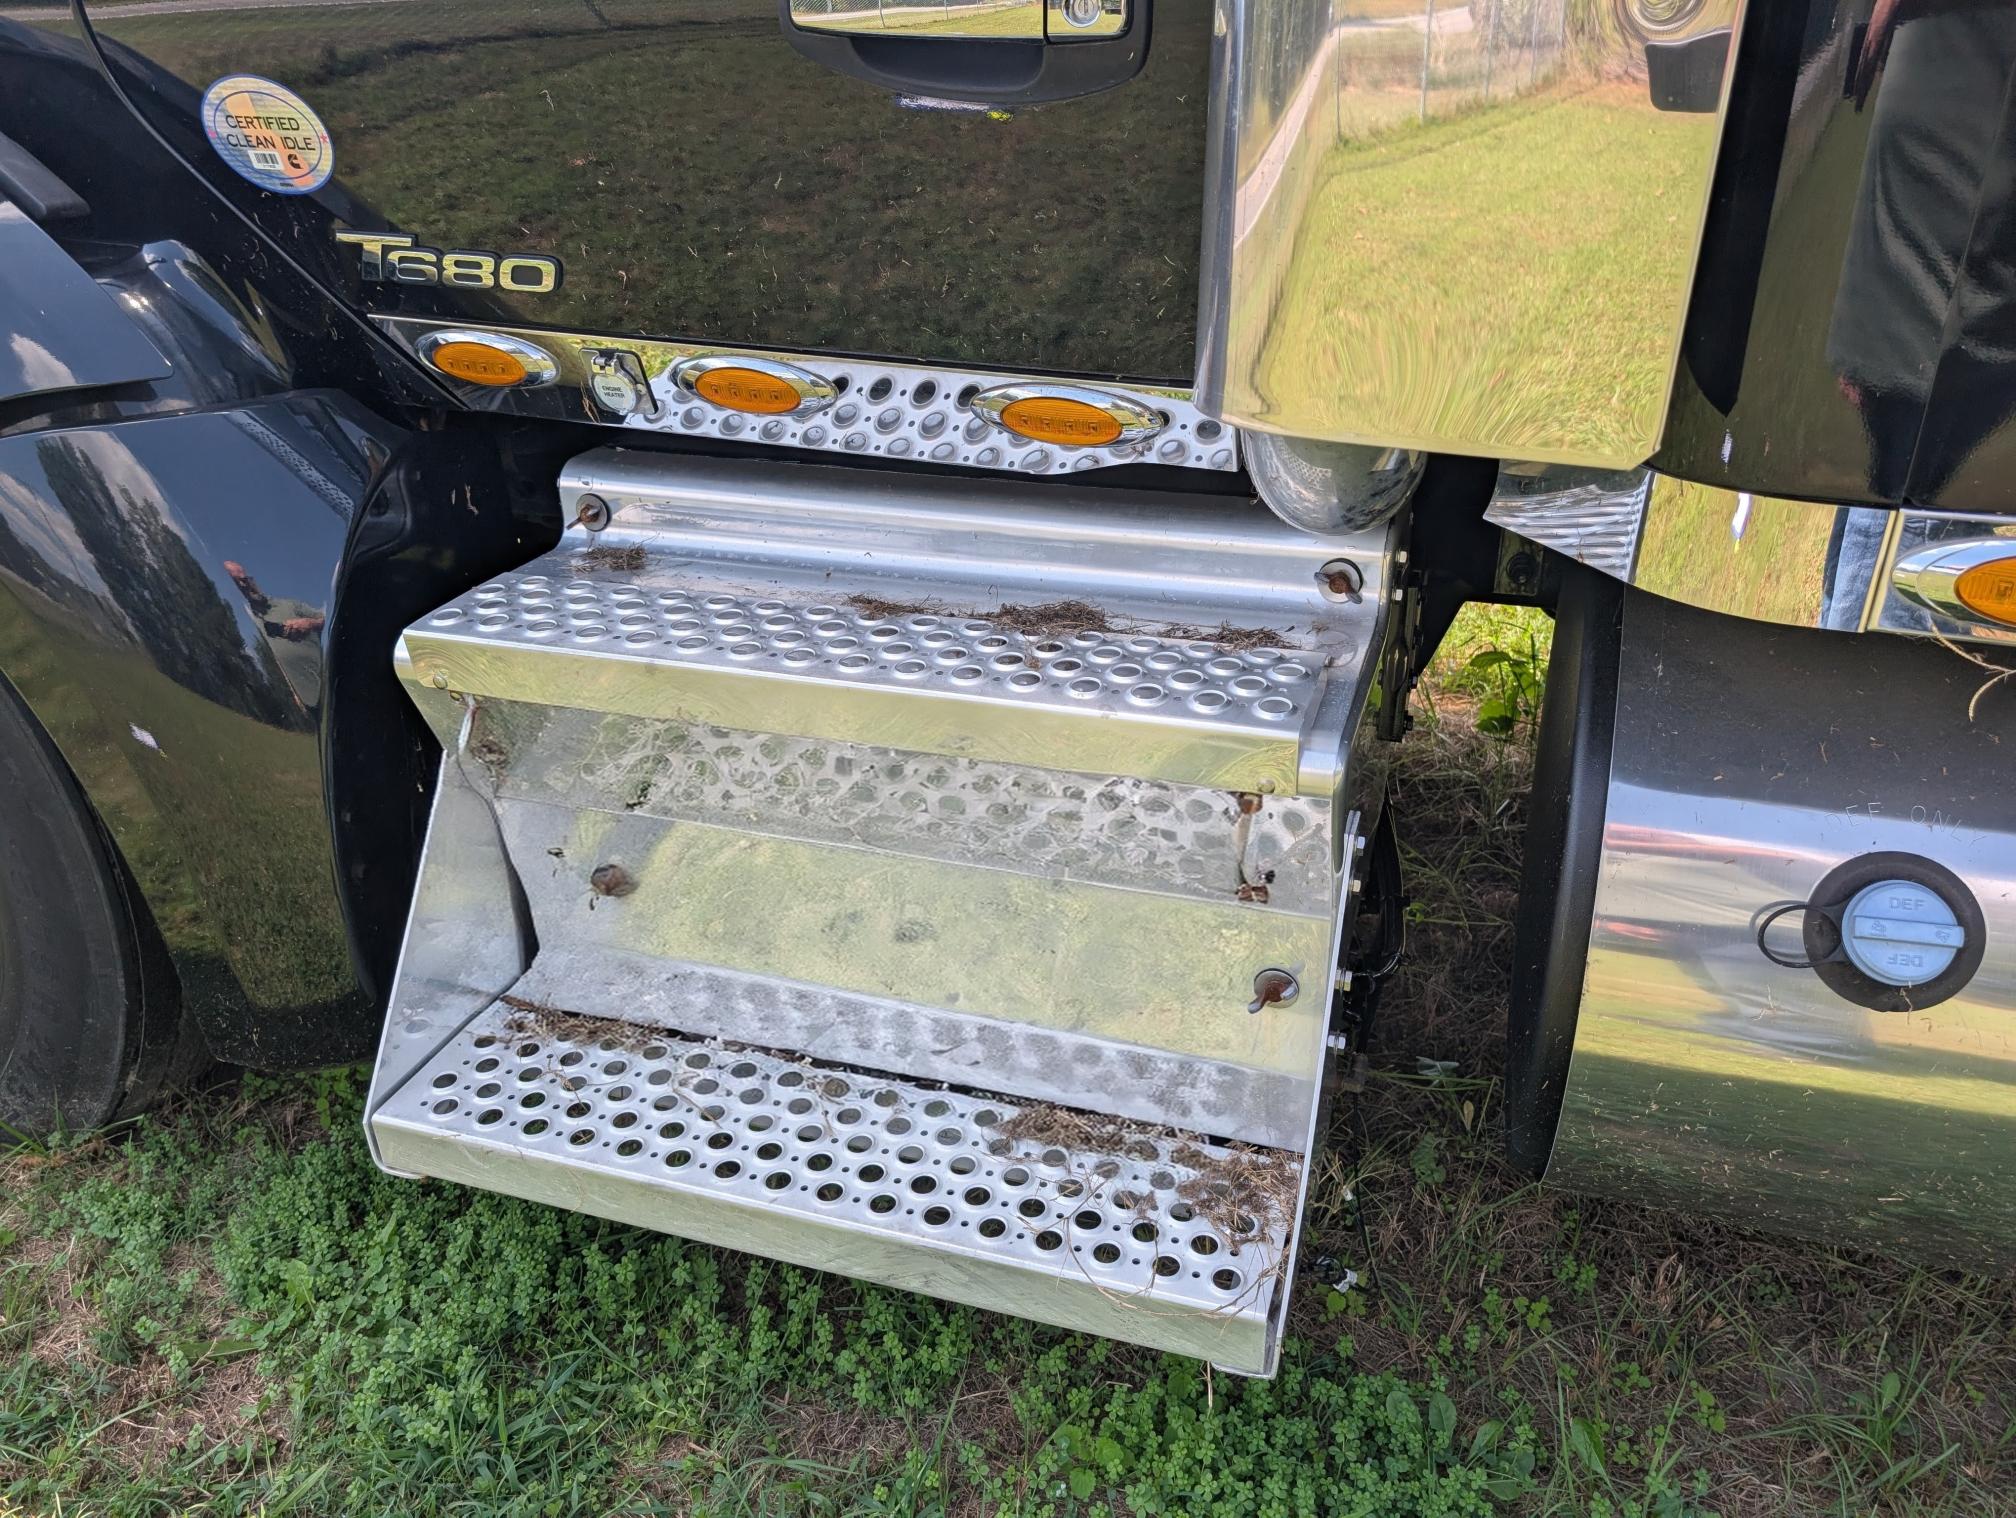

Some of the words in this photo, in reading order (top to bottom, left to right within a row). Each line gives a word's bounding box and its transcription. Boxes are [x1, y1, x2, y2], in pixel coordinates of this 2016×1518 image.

[225, 115, 300, 132] CERTIFIED
[226, 134, 276, 149] CLEAN
[281, 137, 316, 151] IDLE
[335, 231, 559, 293] T680
[601, 385, 623, 393] ENGINE
[603, 391, 626, 399] HEATER
[1888, 896, 1926, 911] DEF
[1886, 953, 1924, 968] DEF
